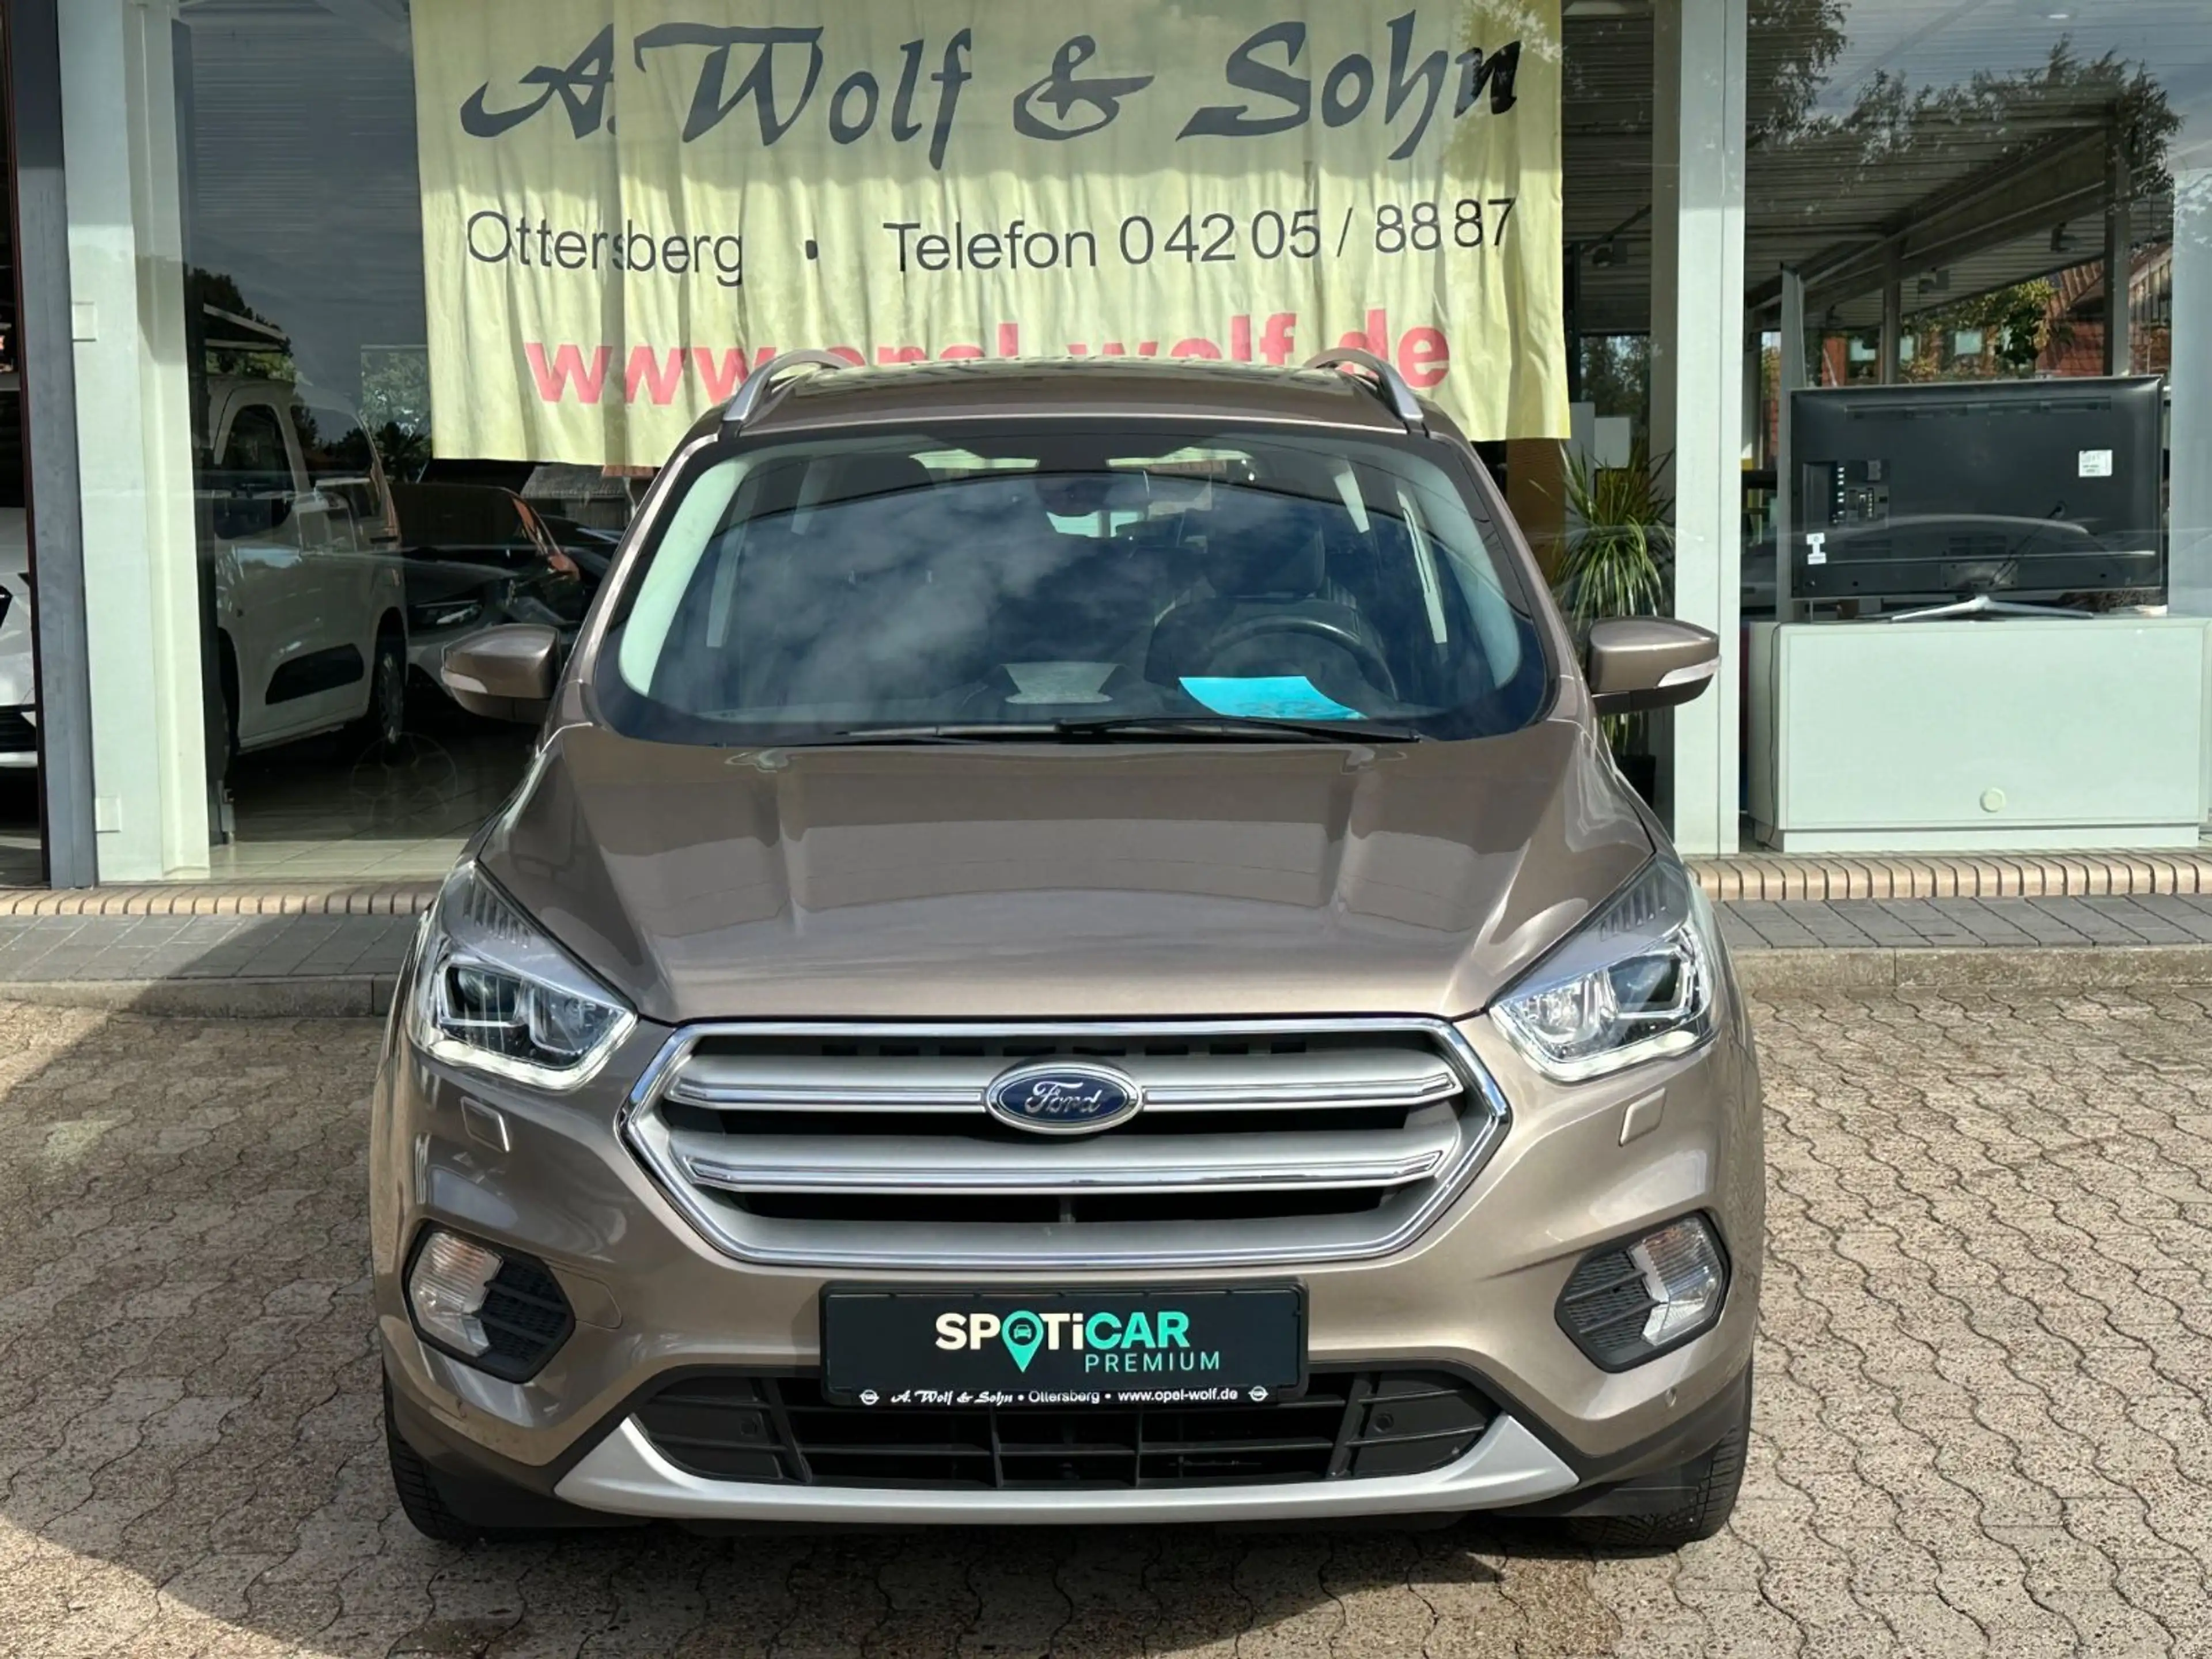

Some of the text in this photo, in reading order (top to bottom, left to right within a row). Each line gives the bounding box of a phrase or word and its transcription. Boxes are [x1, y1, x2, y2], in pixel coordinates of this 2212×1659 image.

[634, 22, 972, 171] Wolf
[1013, 35, 1155, 141] &
[1175, 9, 1521, 160] Sohn
[467, 211, 744, 287] Ottersberg
[883, 221, 1096, 274] Telefon
[1024, 1081, 1103, 1113] Ford
[1085, 1351, 1220, 1373] PREMIUM
[914, 1389, 954, 1406] Wolf
[956, 1391, 974, 1403] &
[974, 1391, 1013, 1406] Sohn
[1028, 1391, 1100, 1404] Ottersberg
[1118, 1388, 1238, 1403] www.opel-wolf.de
